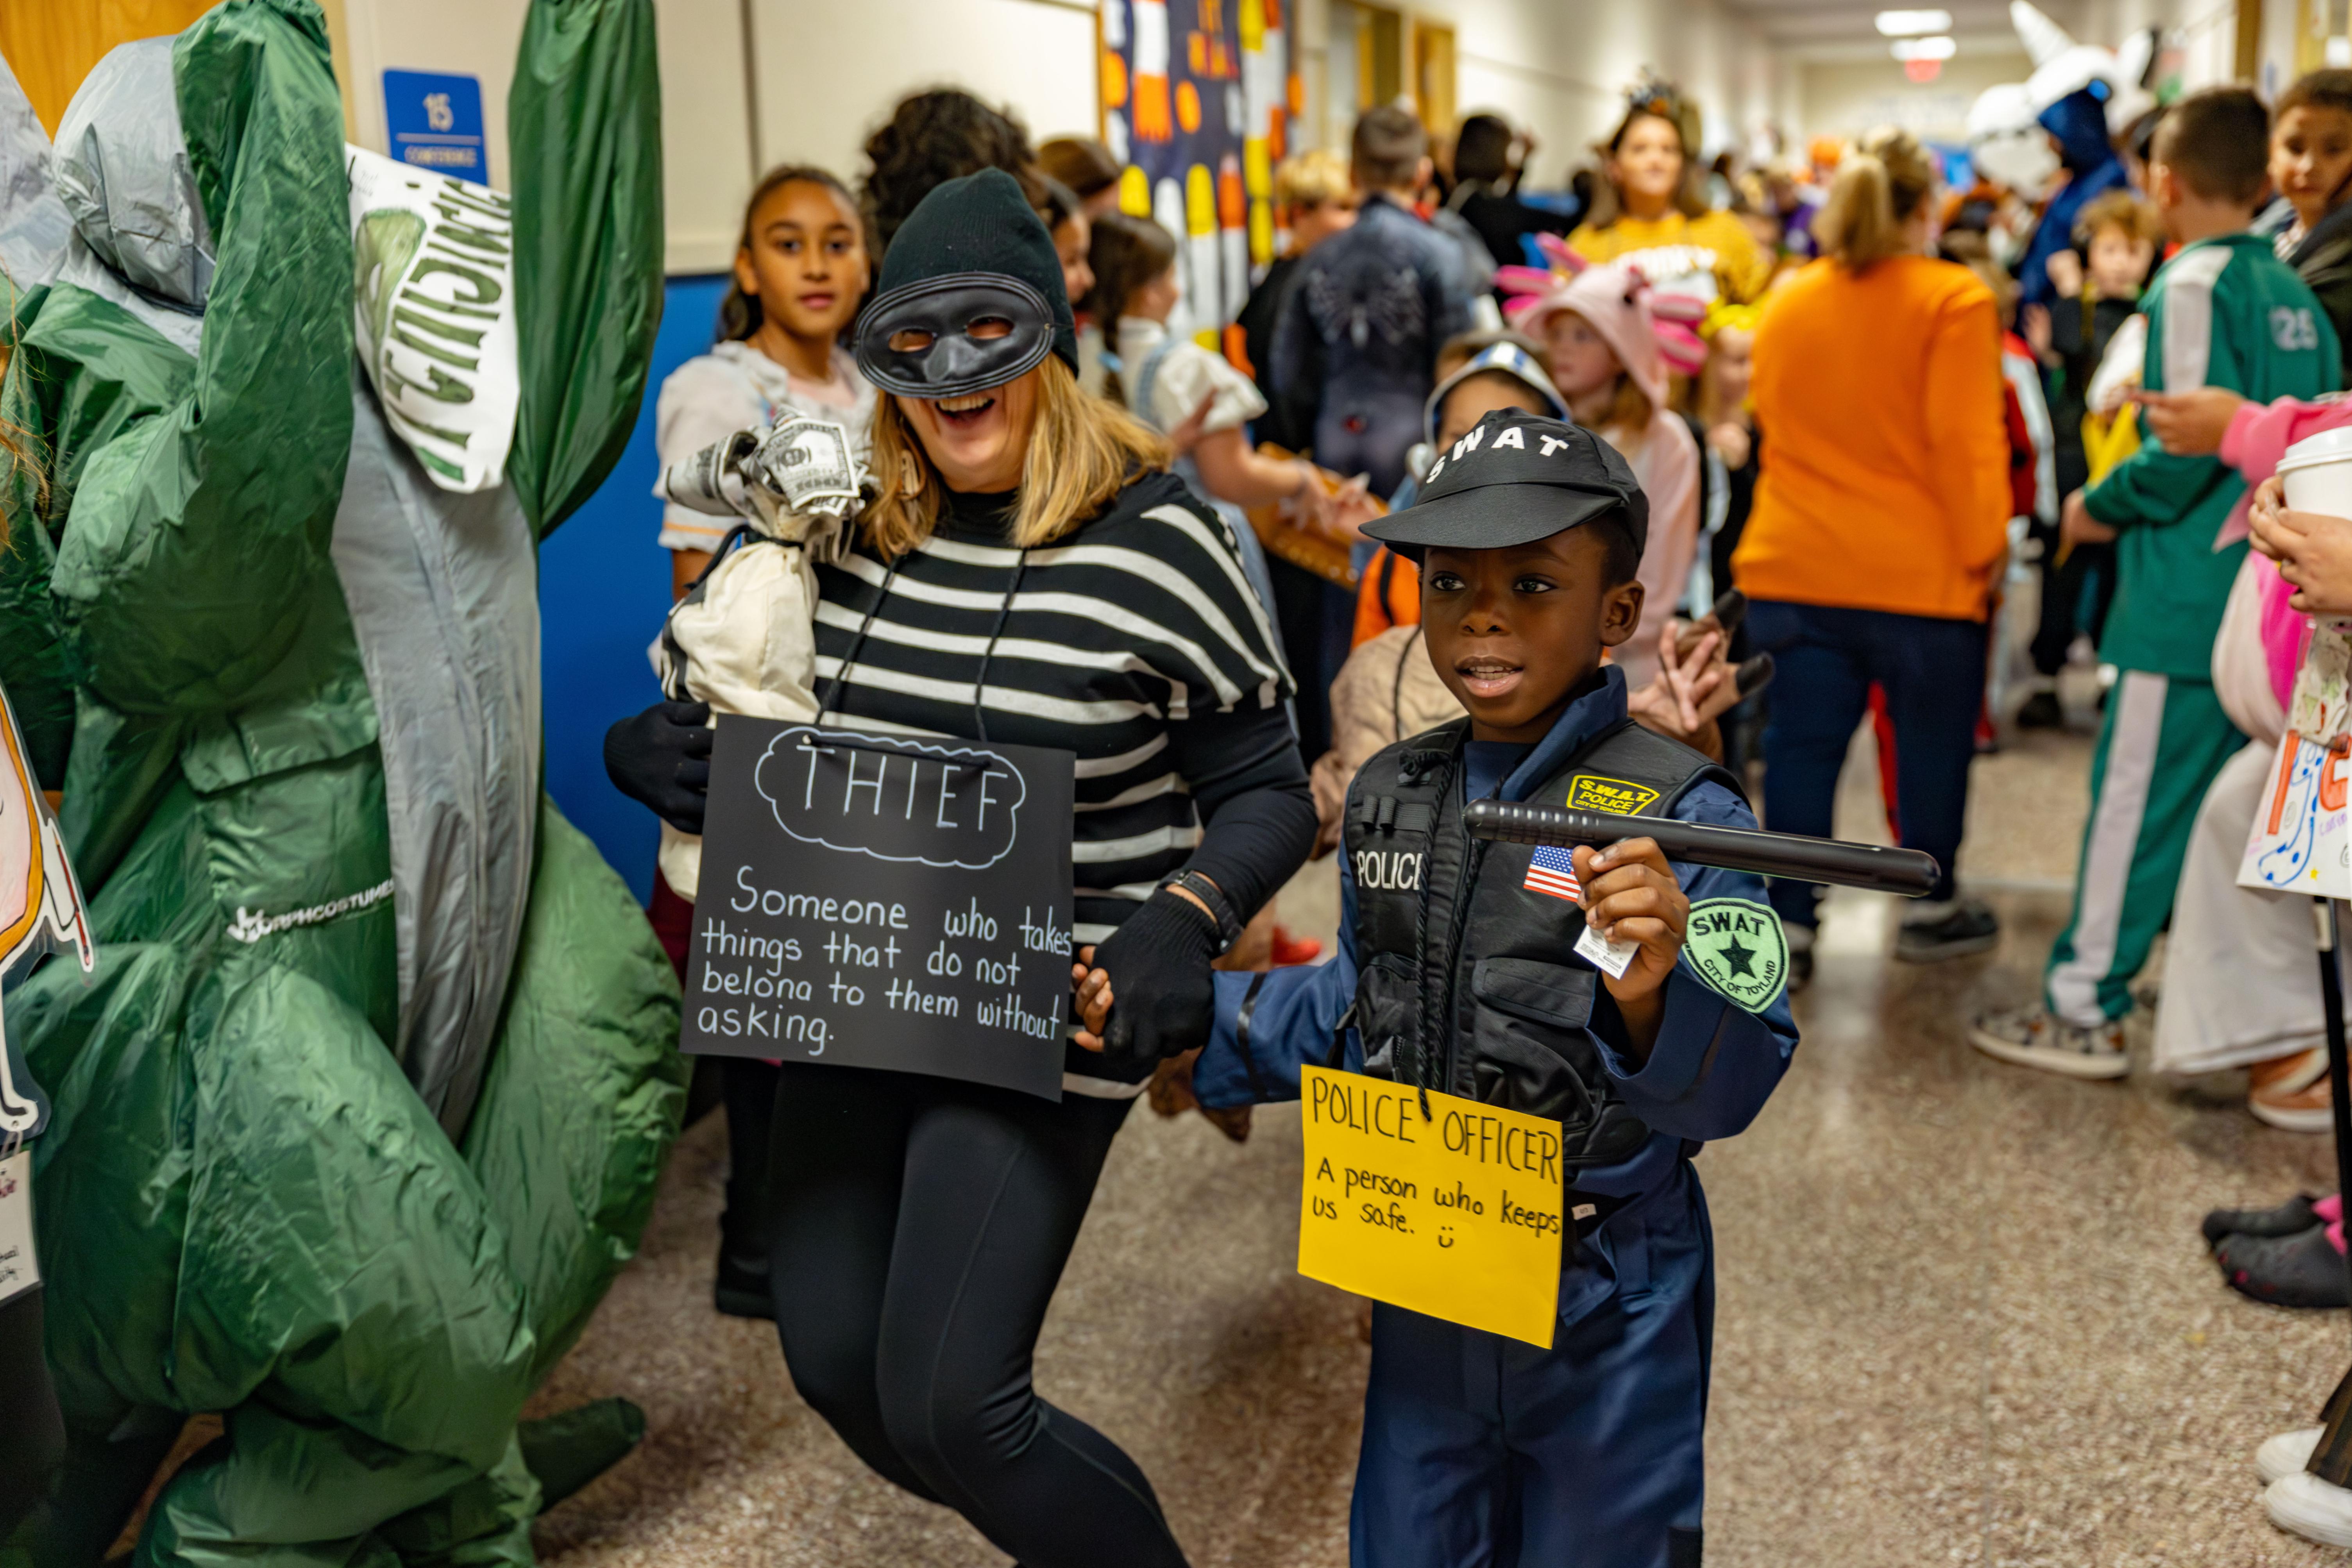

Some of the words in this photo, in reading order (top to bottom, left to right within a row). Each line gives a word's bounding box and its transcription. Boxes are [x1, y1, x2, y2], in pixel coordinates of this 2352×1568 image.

[1426, 424, 1569, 484] SWAT
[796, 744, 1008, 831] THIEF
[1579, 780, 1651, 802] S.W.A.T.
[1579, 790, 1635, 810] POLICE
[731, 866, 909, 929] Someone
[944, 897, 998, 941] who
[1018, 905, 1072, 957] takes
[1692, 912, 1765, 936] SWAT
[701, 917, 802, 976] things
[822, 931, 901, 969] that
[926, 940, 962, 976] do
[976, 952, 1021, 986] not
[1704, 958, 1726, 982] CITY
[1727, 982, 1741, 994] OF
[1744, 960, 1776, 996] TOYLAND
[698, 1001, 835, 1056] asking.
[828, 971, 865, 1005] to
[885, 977, 958, 1017] them
[977, 994, 1060, 1040] without
[1312, 1076, 1415, 1143] POLICE
[1443, 1110, 1558, 1185] OFFICER
[1316, 1157, 1335, 1183] A
[1345, 1167, 1417, 1198] person
[1434, 1180, 1484, 1216] who
[1501, 1189, 1561, 1238] keeps
[1359, 1202, 1415, 1235] safe.
